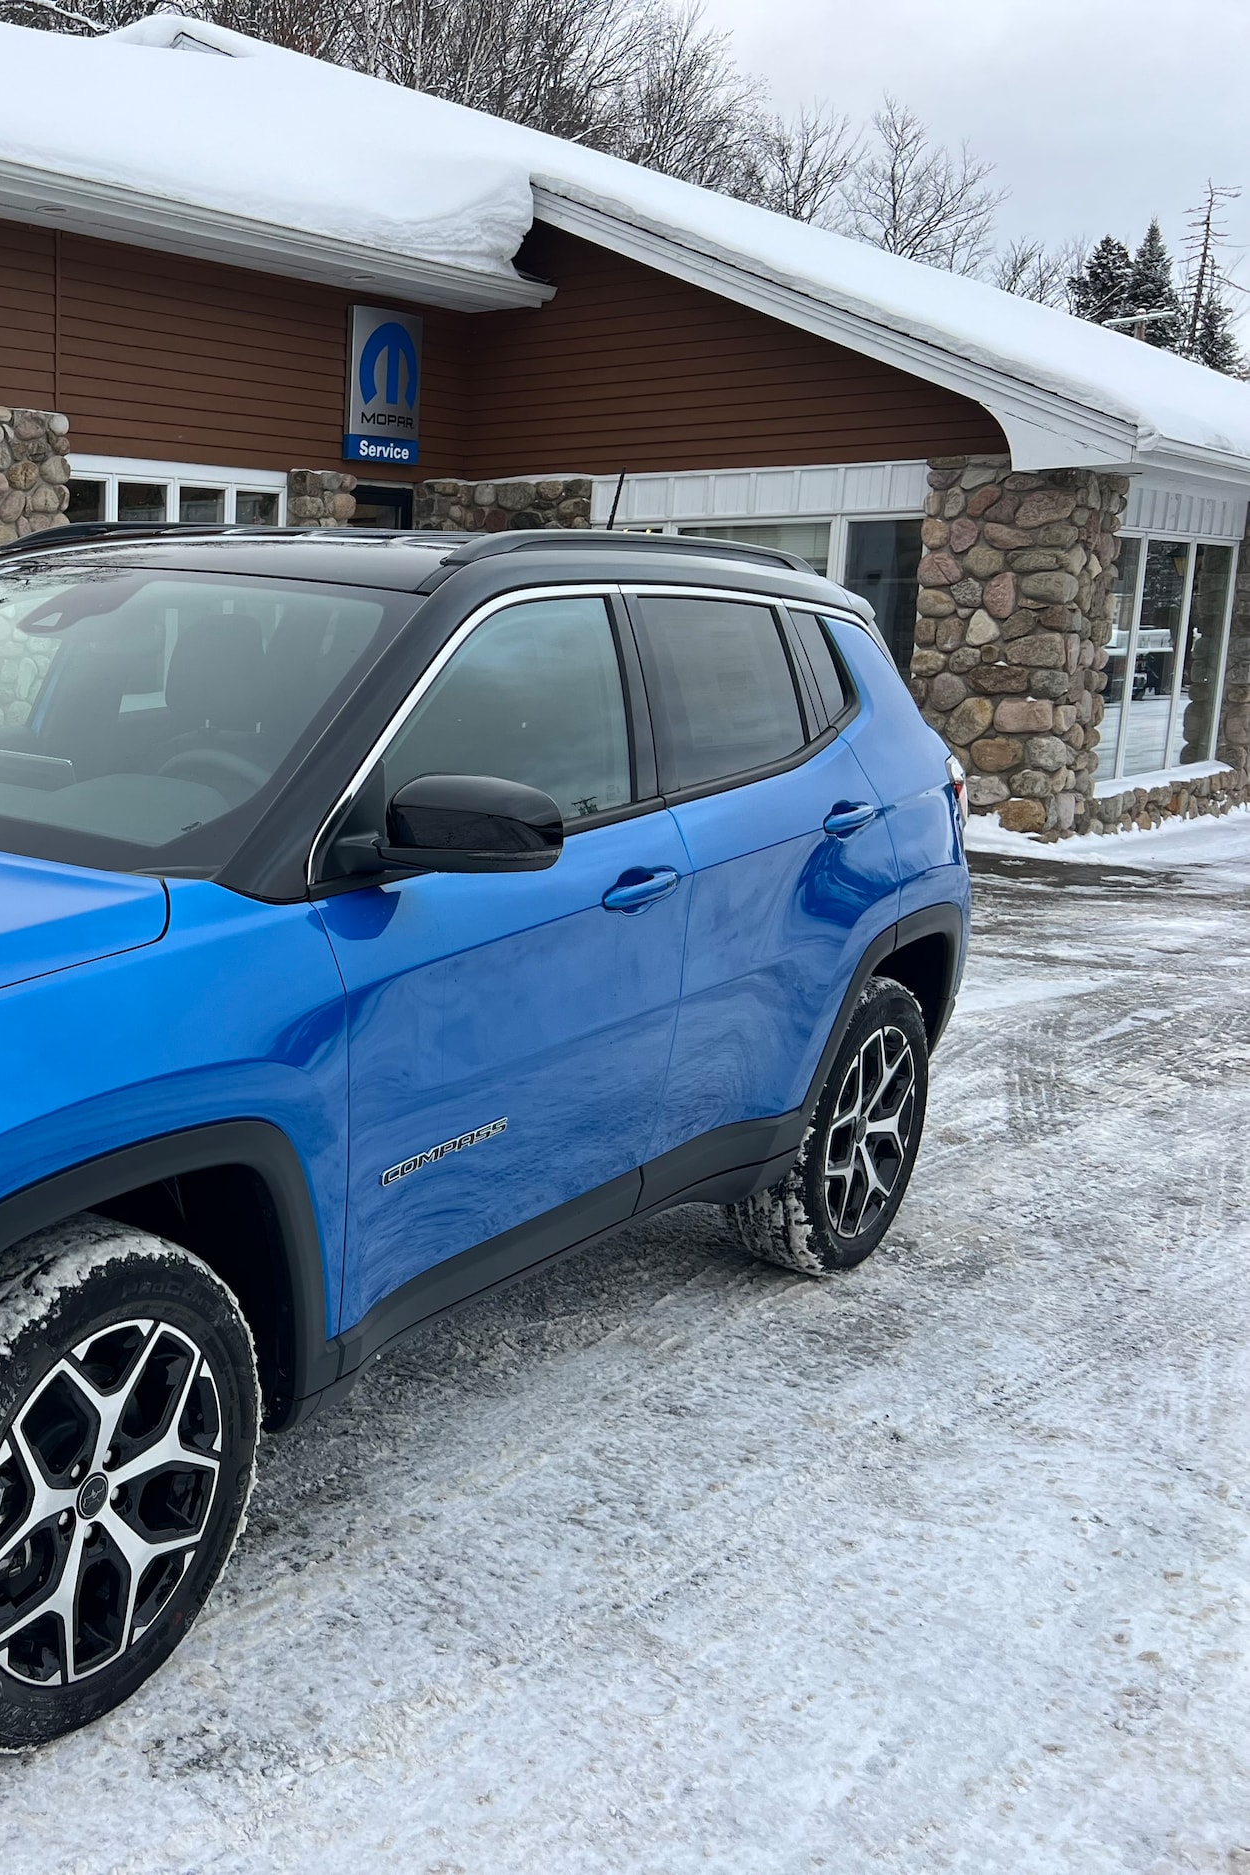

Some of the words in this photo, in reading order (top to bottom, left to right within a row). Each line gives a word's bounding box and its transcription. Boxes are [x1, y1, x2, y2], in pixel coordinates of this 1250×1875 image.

[361, 411, 413, 428] MOPAR
[359, 439, 409, 459] Service
[381, 1115, 508, 1187] COMPASS
